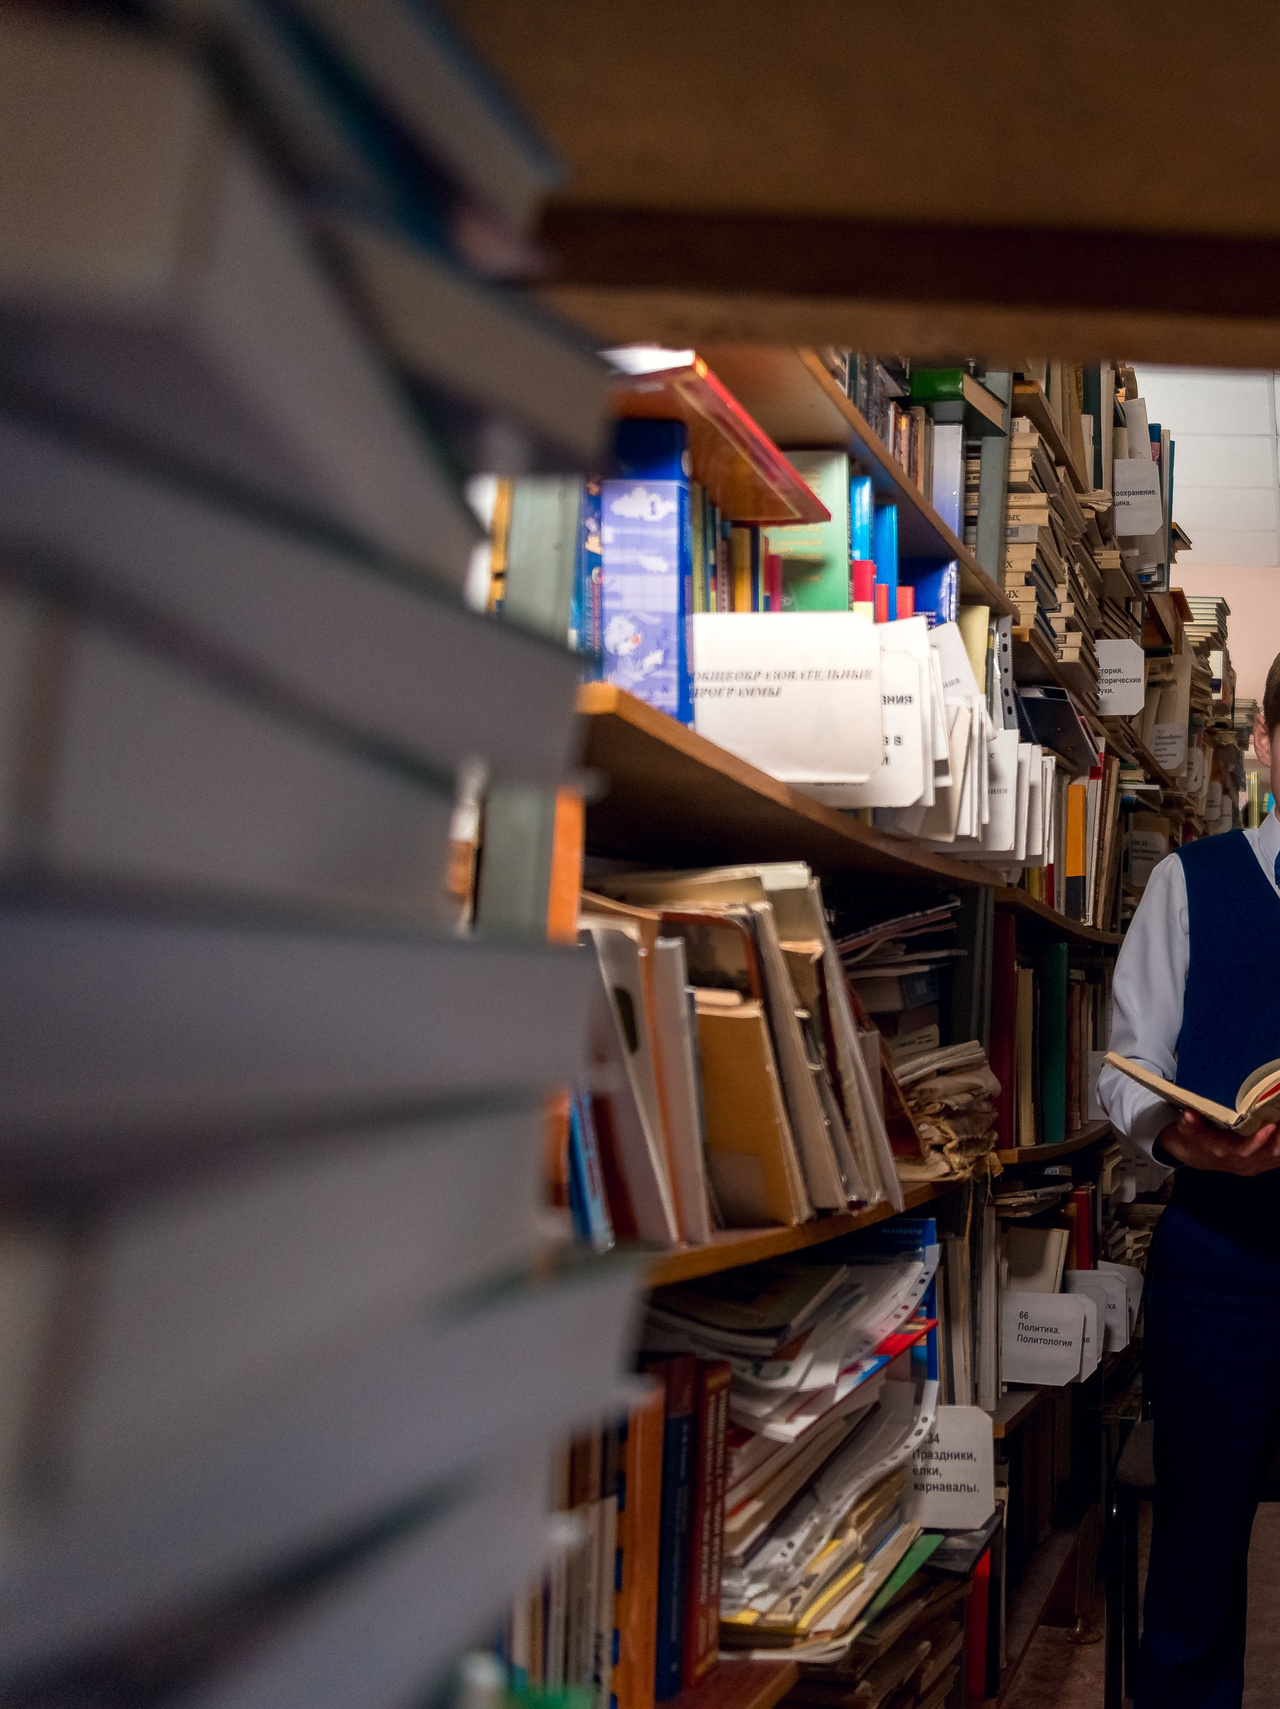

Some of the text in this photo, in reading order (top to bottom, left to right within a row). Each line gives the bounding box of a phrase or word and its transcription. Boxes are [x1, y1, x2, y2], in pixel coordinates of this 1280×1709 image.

[1019, 1311, 1029, 1320] 66
[1018, 1322, 1060, 1334] Политика.
[1016, 1334, 1073, 1347] Политология
[913, 1465, 942, 1477] ёлки,
[913, 1482, 980, 1494] карнавалы.
